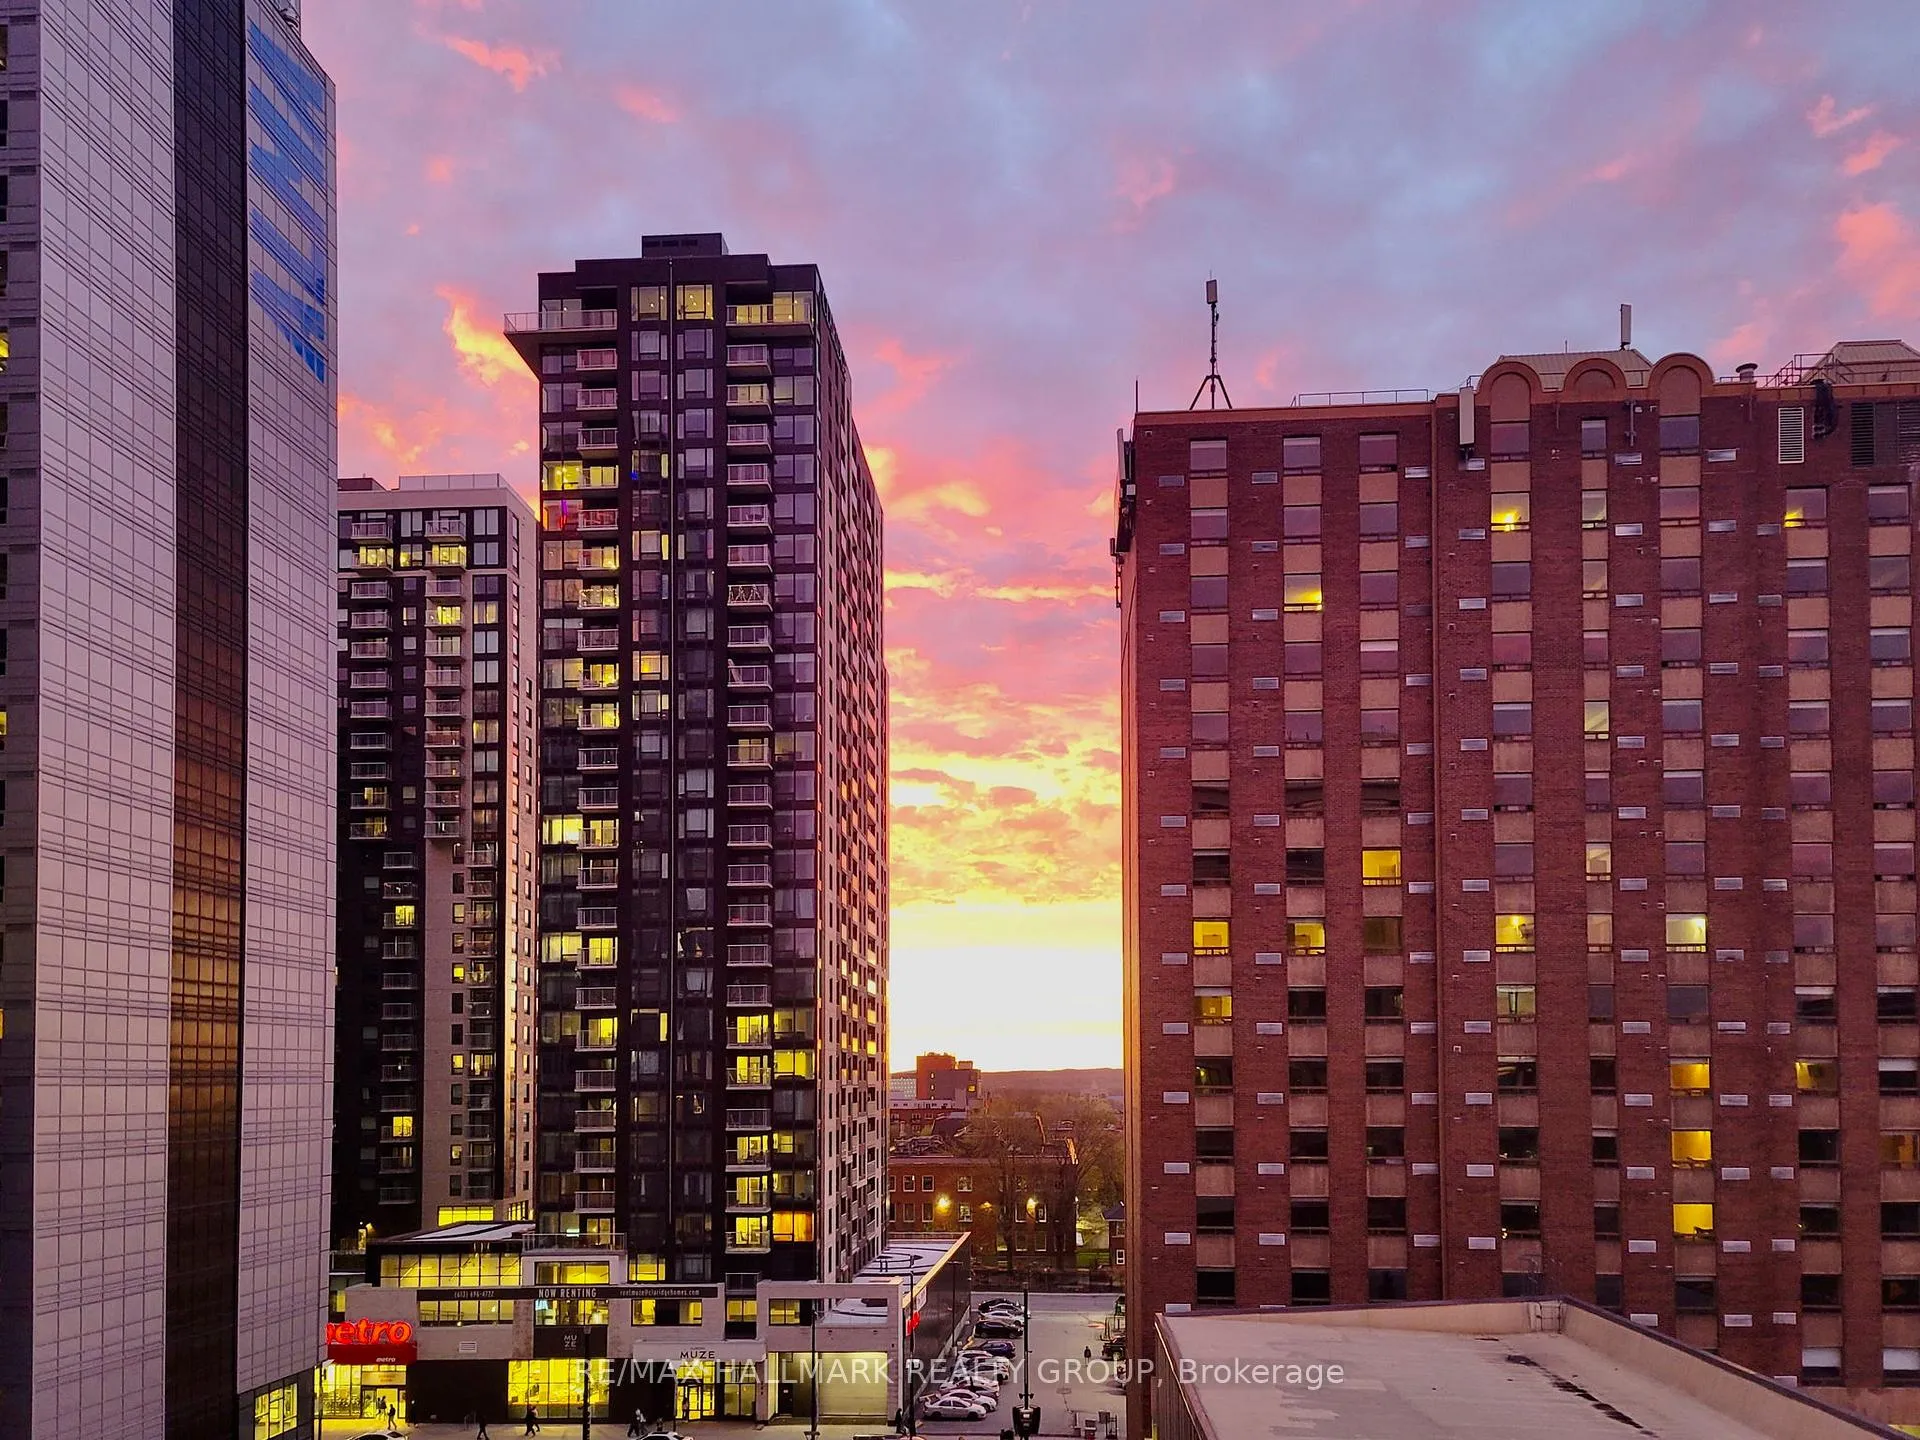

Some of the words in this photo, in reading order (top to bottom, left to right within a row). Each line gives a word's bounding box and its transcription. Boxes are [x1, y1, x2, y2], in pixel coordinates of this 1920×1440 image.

[538, 1288, 556, 1298] NOW
[560, 1288, 597, 1298] RENTING
[680, 1351, 715, 1359] MUZE
